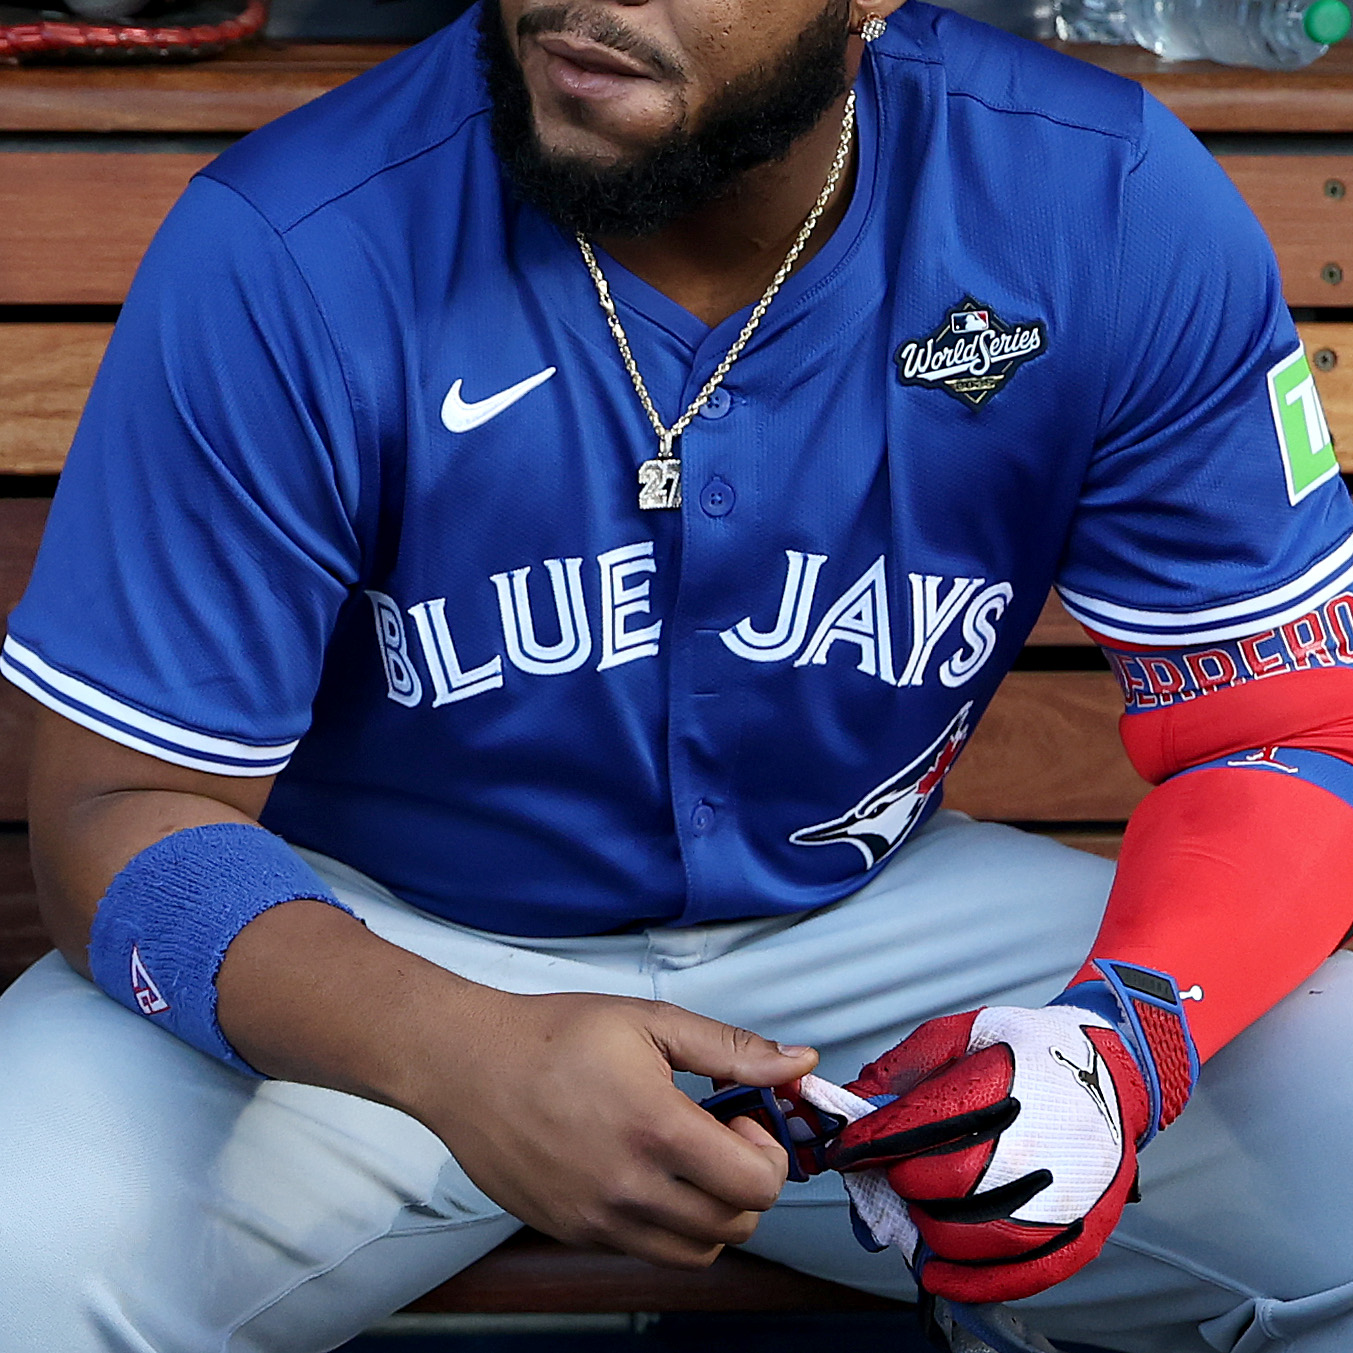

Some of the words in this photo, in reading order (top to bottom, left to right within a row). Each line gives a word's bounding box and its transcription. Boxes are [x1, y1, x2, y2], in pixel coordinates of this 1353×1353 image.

[901, 334, 980, 379] World
[968, 326, 1041, 376] Series
[1285, 372, 1331, 455] T
[638, 458, 682, 510] 27
[364, 540, 663, 709] BLUE
[718, 549, 1014, 688] JAYS
